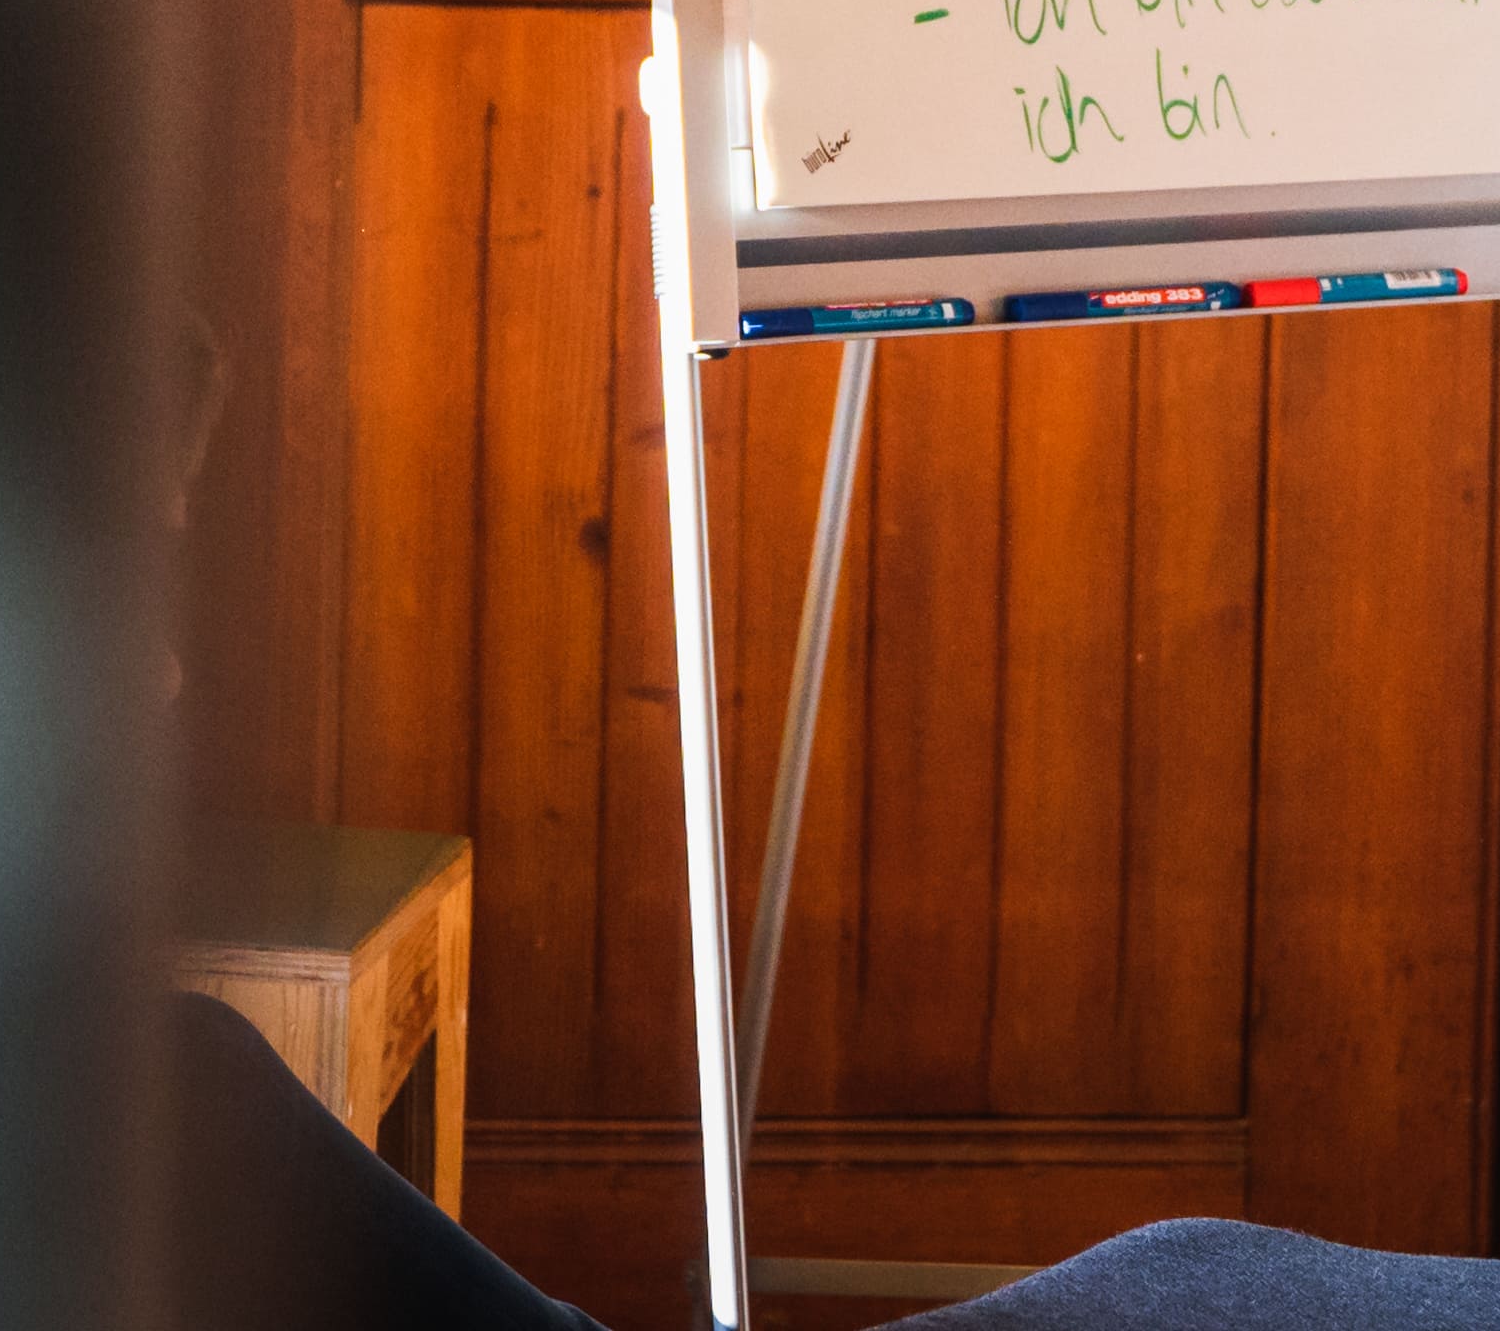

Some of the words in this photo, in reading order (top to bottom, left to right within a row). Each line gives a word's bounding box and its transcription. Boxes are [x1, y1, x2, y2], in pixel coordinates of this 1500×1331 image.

[1013, 65, 1125, 164] ich
[1104, 290, 1162, 305] edding
[1165, 287, 1204, 301] 383
